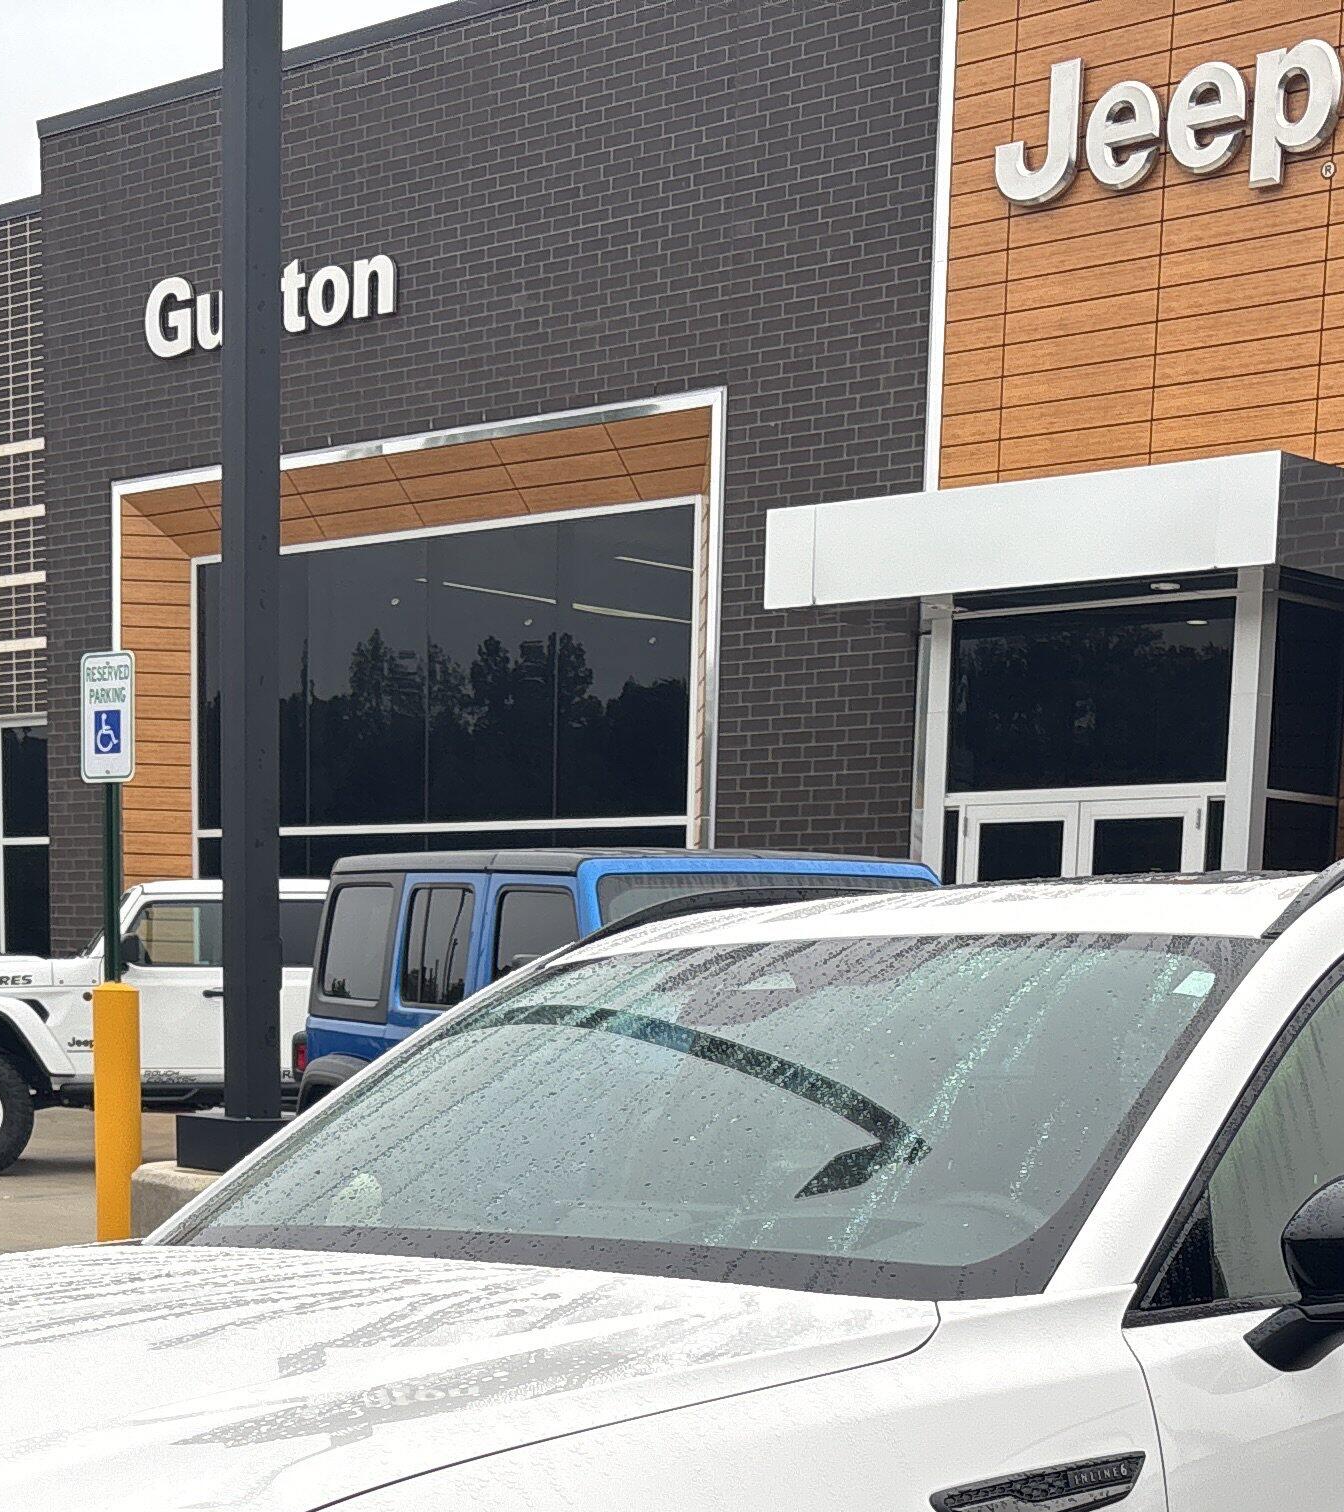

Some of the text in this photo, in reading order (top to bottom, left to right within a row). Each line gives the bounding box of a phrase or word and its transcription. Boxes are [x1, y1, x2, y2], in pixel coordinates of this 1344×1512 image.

[994, 38, 1344, 206] Jeep
[144, 254, 398, 358] Guton
[86, 664, 130, 682] RESERVED
[89, 687, 127, 703] PARKING
